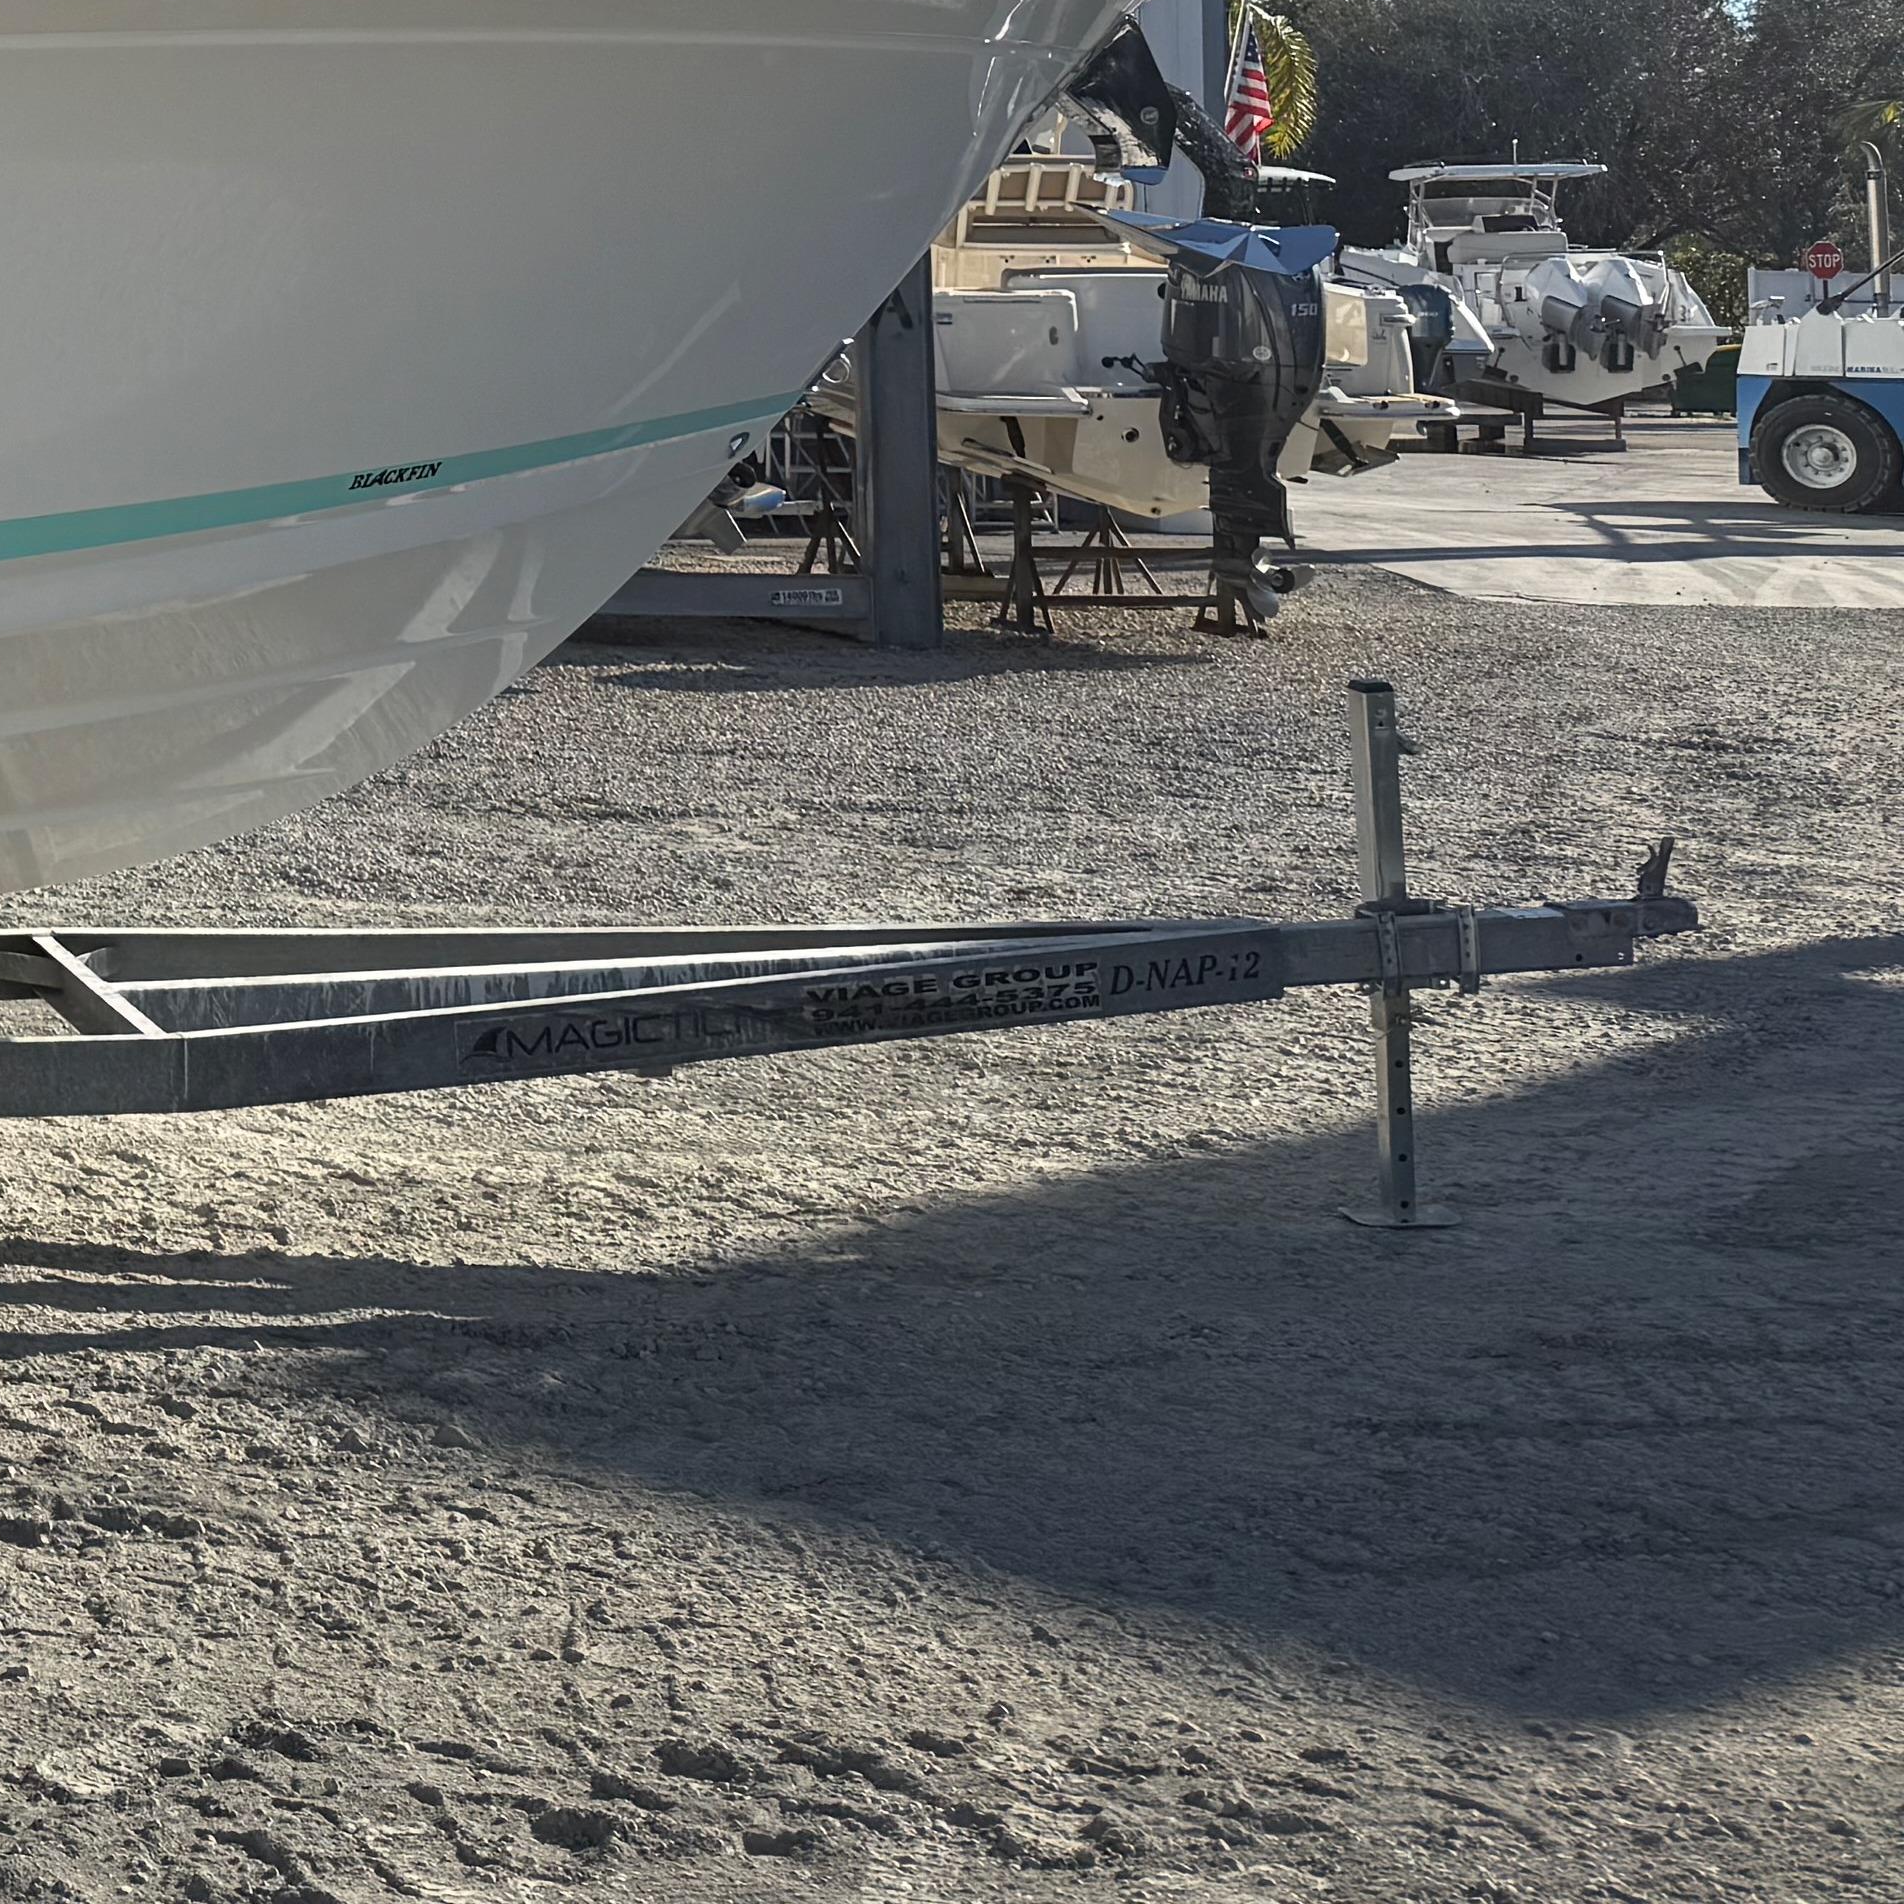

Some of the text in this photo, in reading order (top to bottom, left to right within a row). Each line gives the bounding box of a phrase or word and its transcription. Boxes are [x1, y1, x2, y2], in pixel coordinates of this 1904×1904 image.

[1807, 253, 1842, 269] STOP
[1180, 272, 1229, 304] YAMAHA
[1291, 302, 1318, 317] 150
[348, 461, 443, 491] BLACKFIN
[806, 962, 1098, 1004] VIAGE GROUP
[812, 980, 1095, 1023] 941-444-5375
